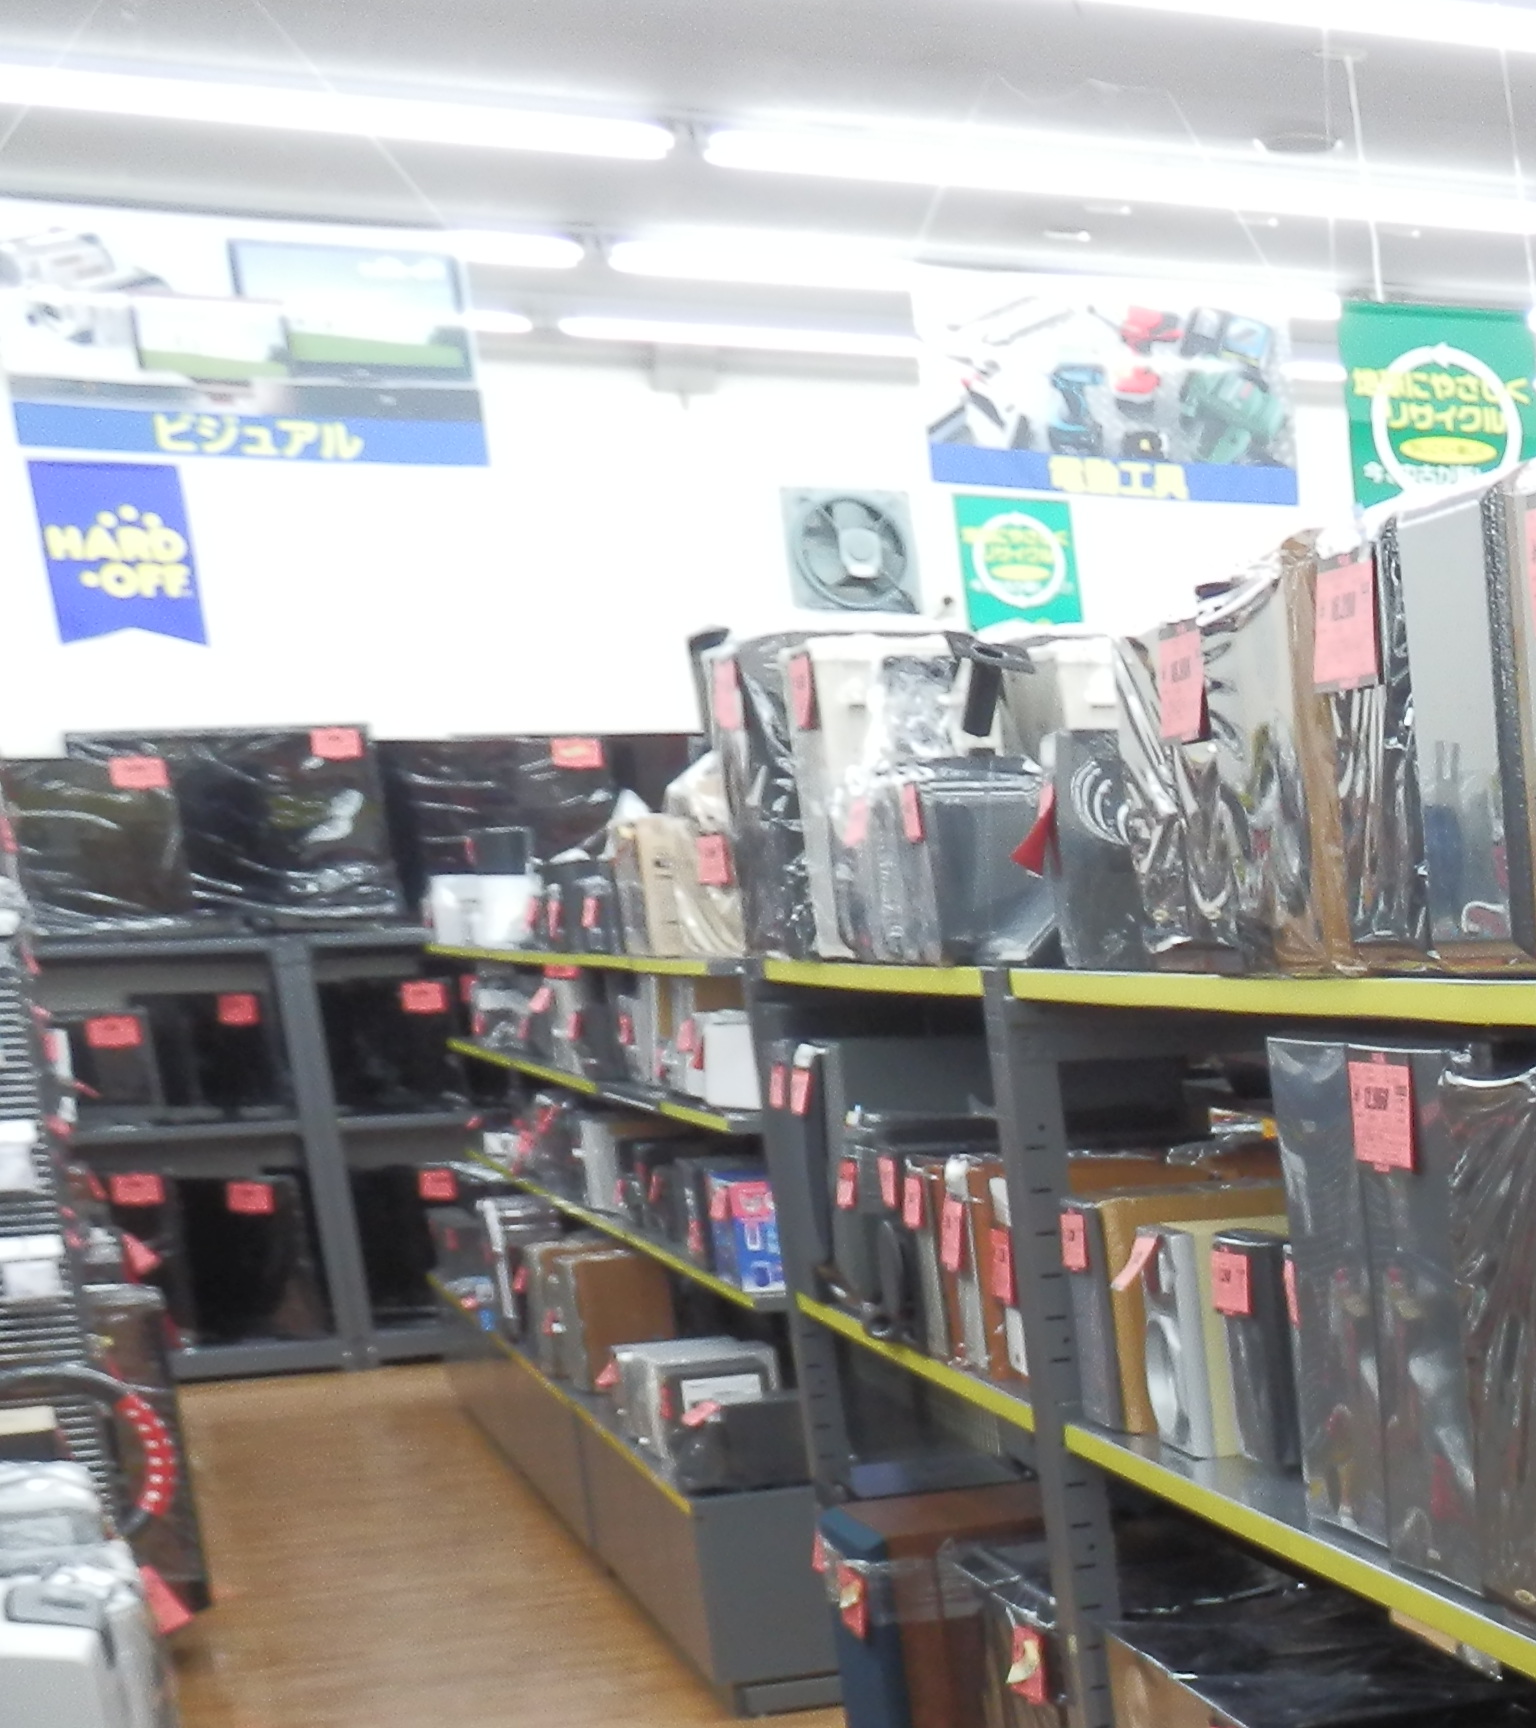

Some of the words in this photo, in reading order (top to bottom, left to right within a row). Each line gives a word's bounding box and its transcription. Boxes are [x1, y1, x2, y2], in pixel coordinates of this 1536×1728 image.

[153, 410, 366, 460] ビジュアル
[1386, 400, 1508, 434] リサイクル
[44, 523, 189, 563] HARD
